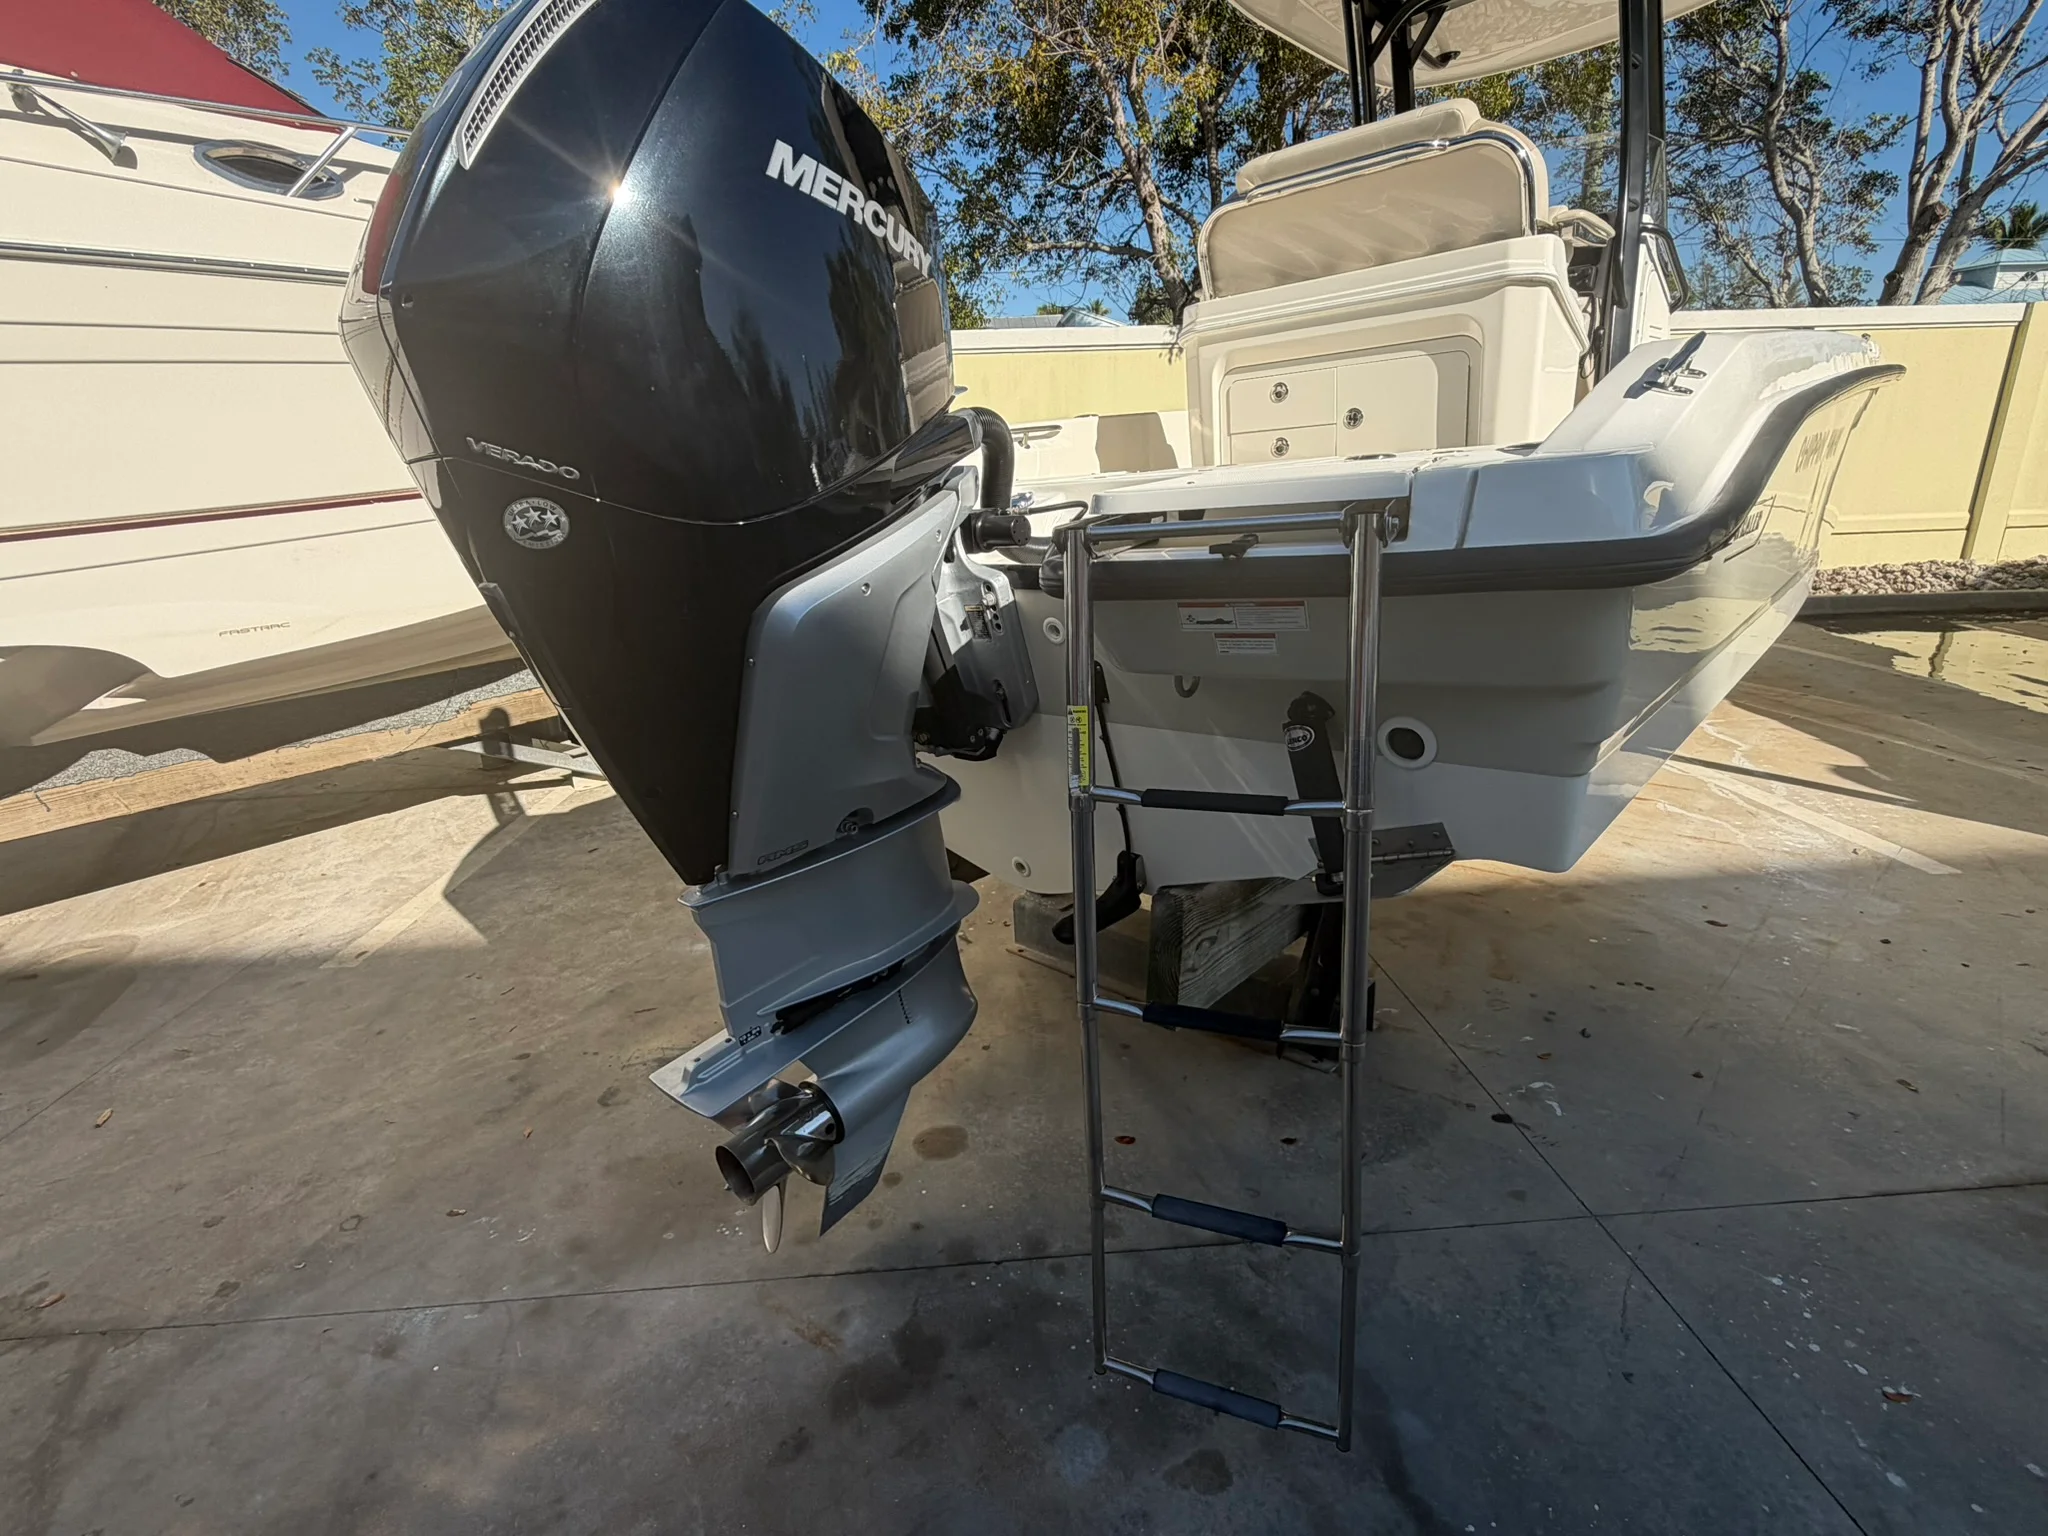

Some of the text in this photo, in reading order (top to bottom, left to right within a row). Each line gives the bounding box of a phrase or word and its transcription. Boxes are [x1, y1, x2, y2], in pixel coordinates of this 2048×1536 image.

[765, 138, 932, 278] MERCURY
[466, 436, 580, 480] VERADO
[219, 621, 290, 637] FASTRAC
